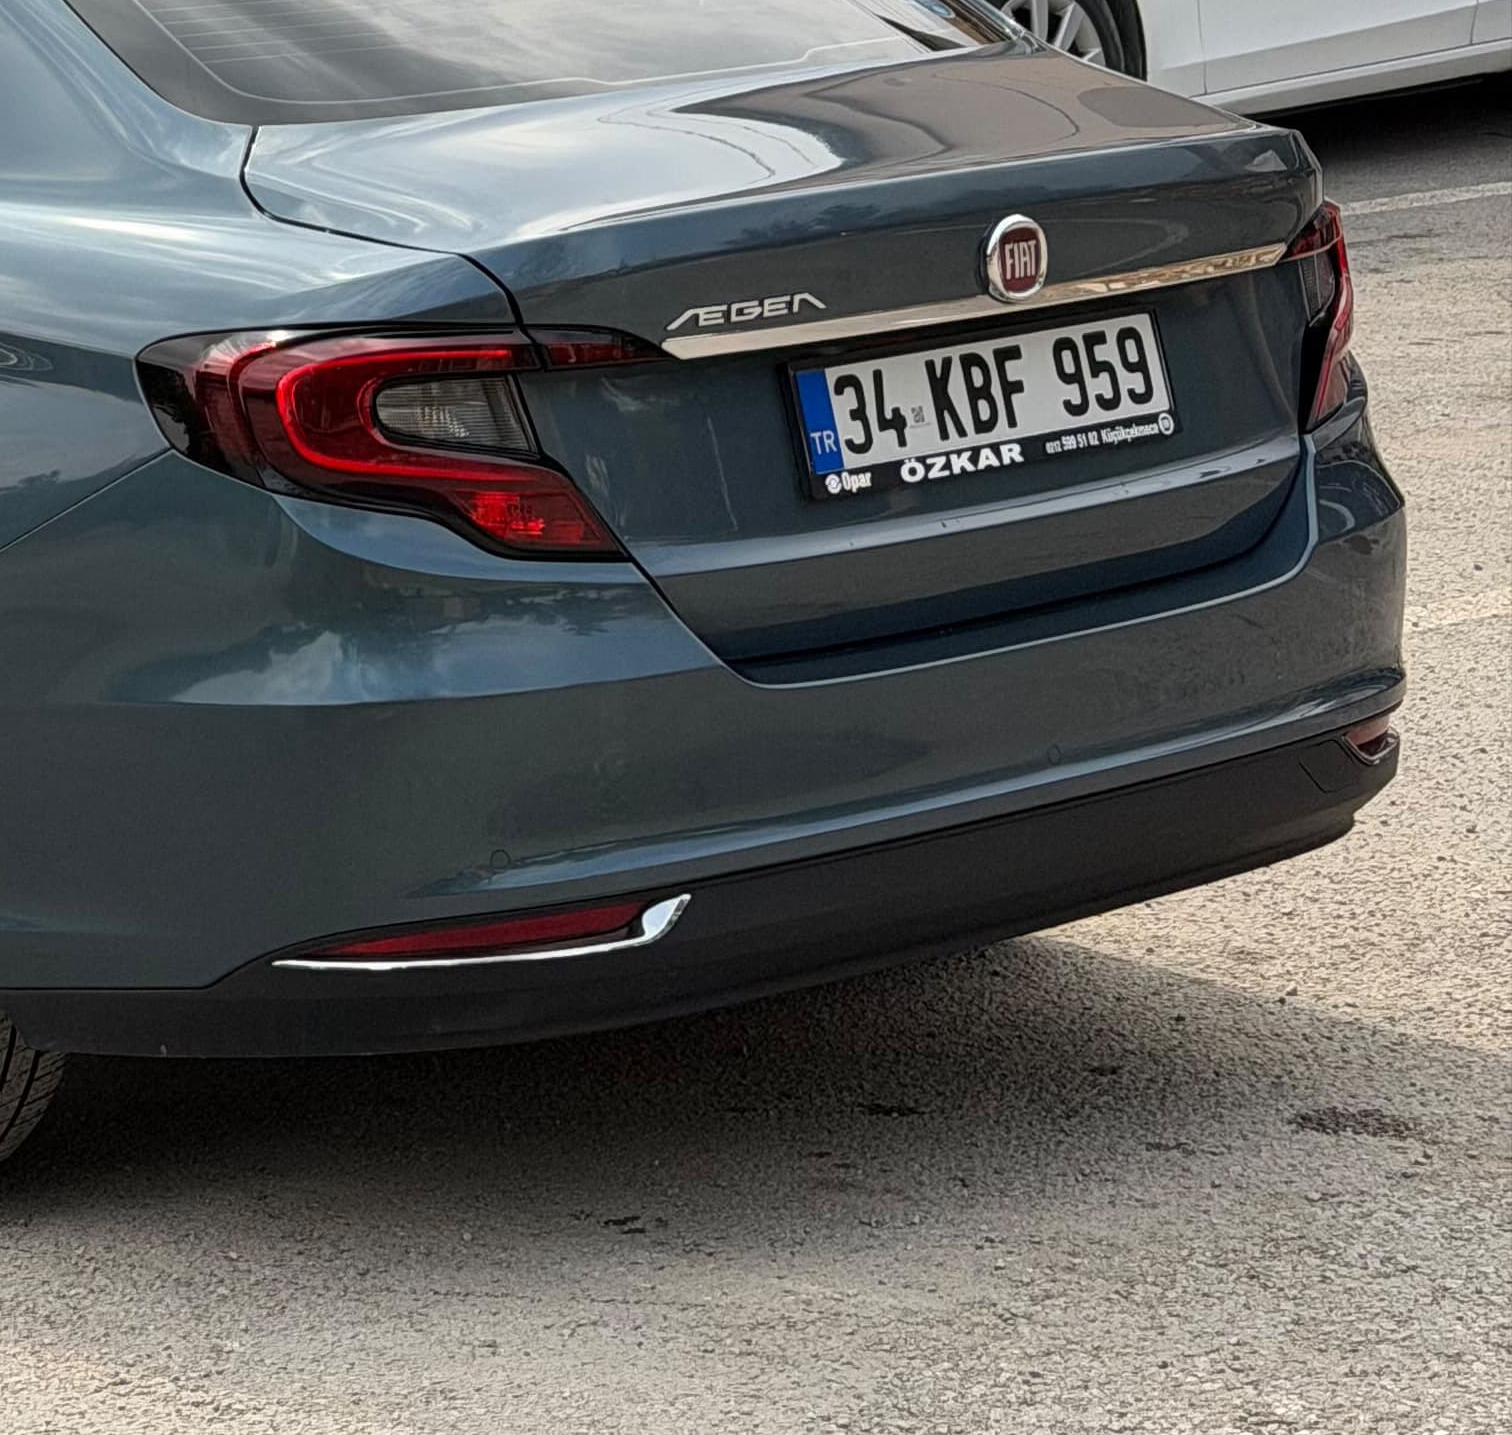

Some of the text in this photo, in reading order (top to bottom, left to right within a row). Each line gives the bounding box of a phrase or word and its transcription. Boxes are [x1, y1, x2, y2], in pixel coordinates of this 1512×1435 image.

[1004, 239, 1037, 280] FIAT
[833, 326, 1154, 455] 34 KBF 959
[810, 430, 837, 455] TR
[841, 471, 872, 493] Opar
[900, 443, 1025, 483] ÖZKAR
